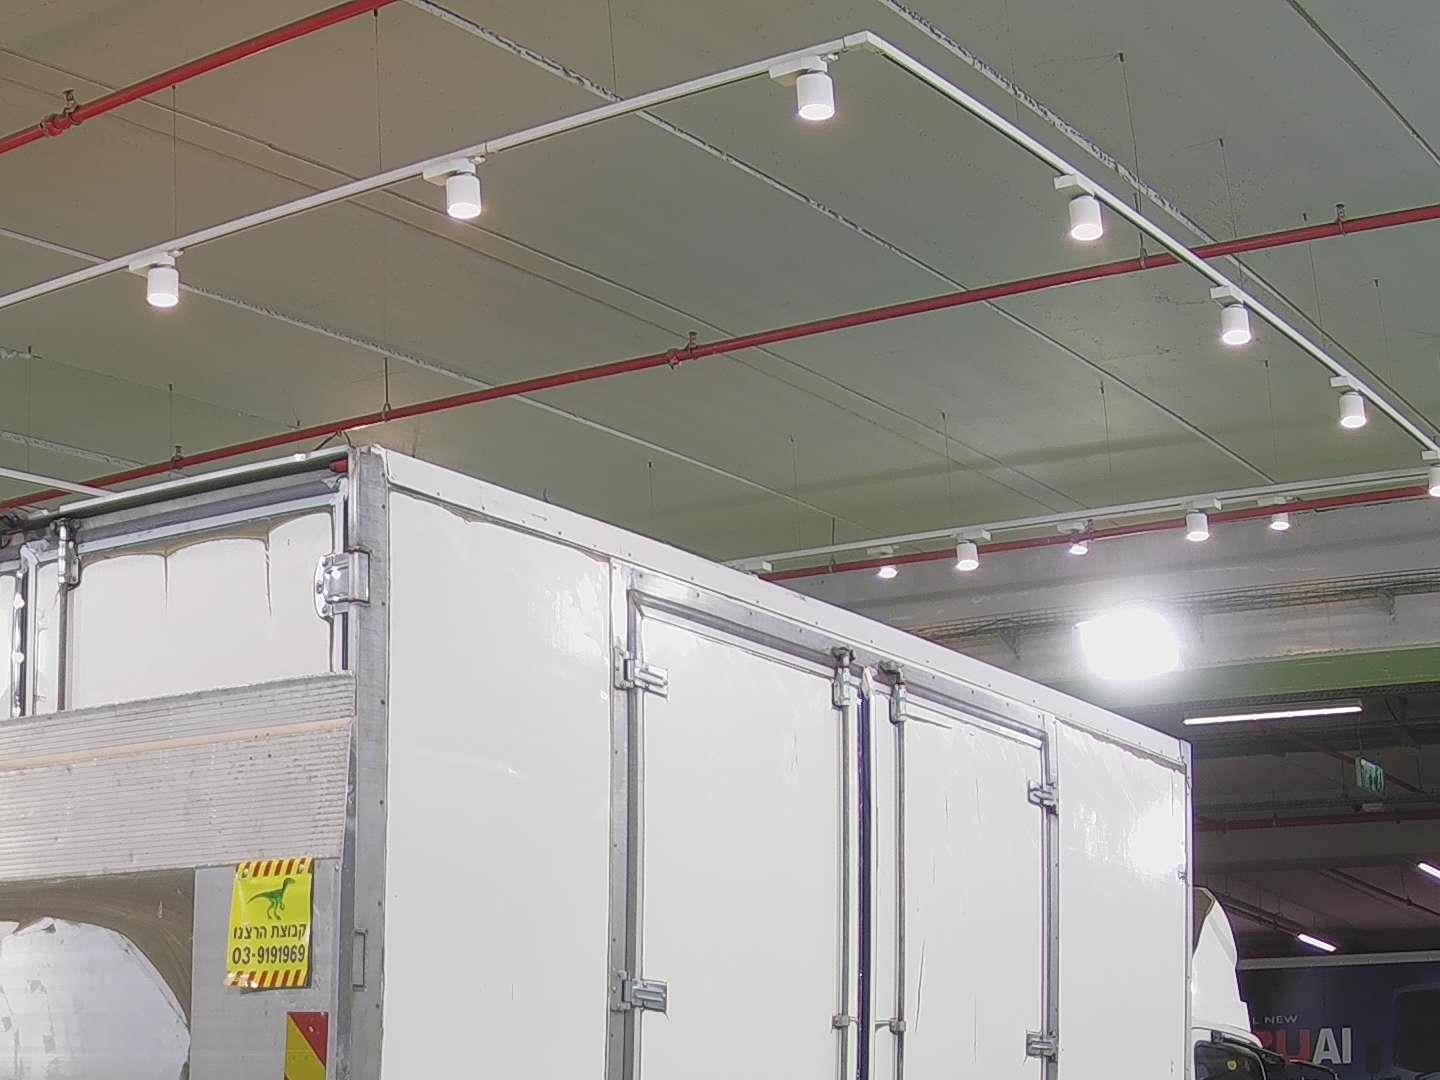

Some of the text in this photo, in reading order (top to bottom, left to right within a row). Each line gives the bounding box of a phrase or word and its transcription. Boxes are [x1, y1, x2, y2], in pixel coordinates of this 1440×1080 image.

[271, 923, 307, 940] קבוצת
[232, 943, 306, 965] 03-9191969
[1264, 1015, 1298, 1025] NEW
